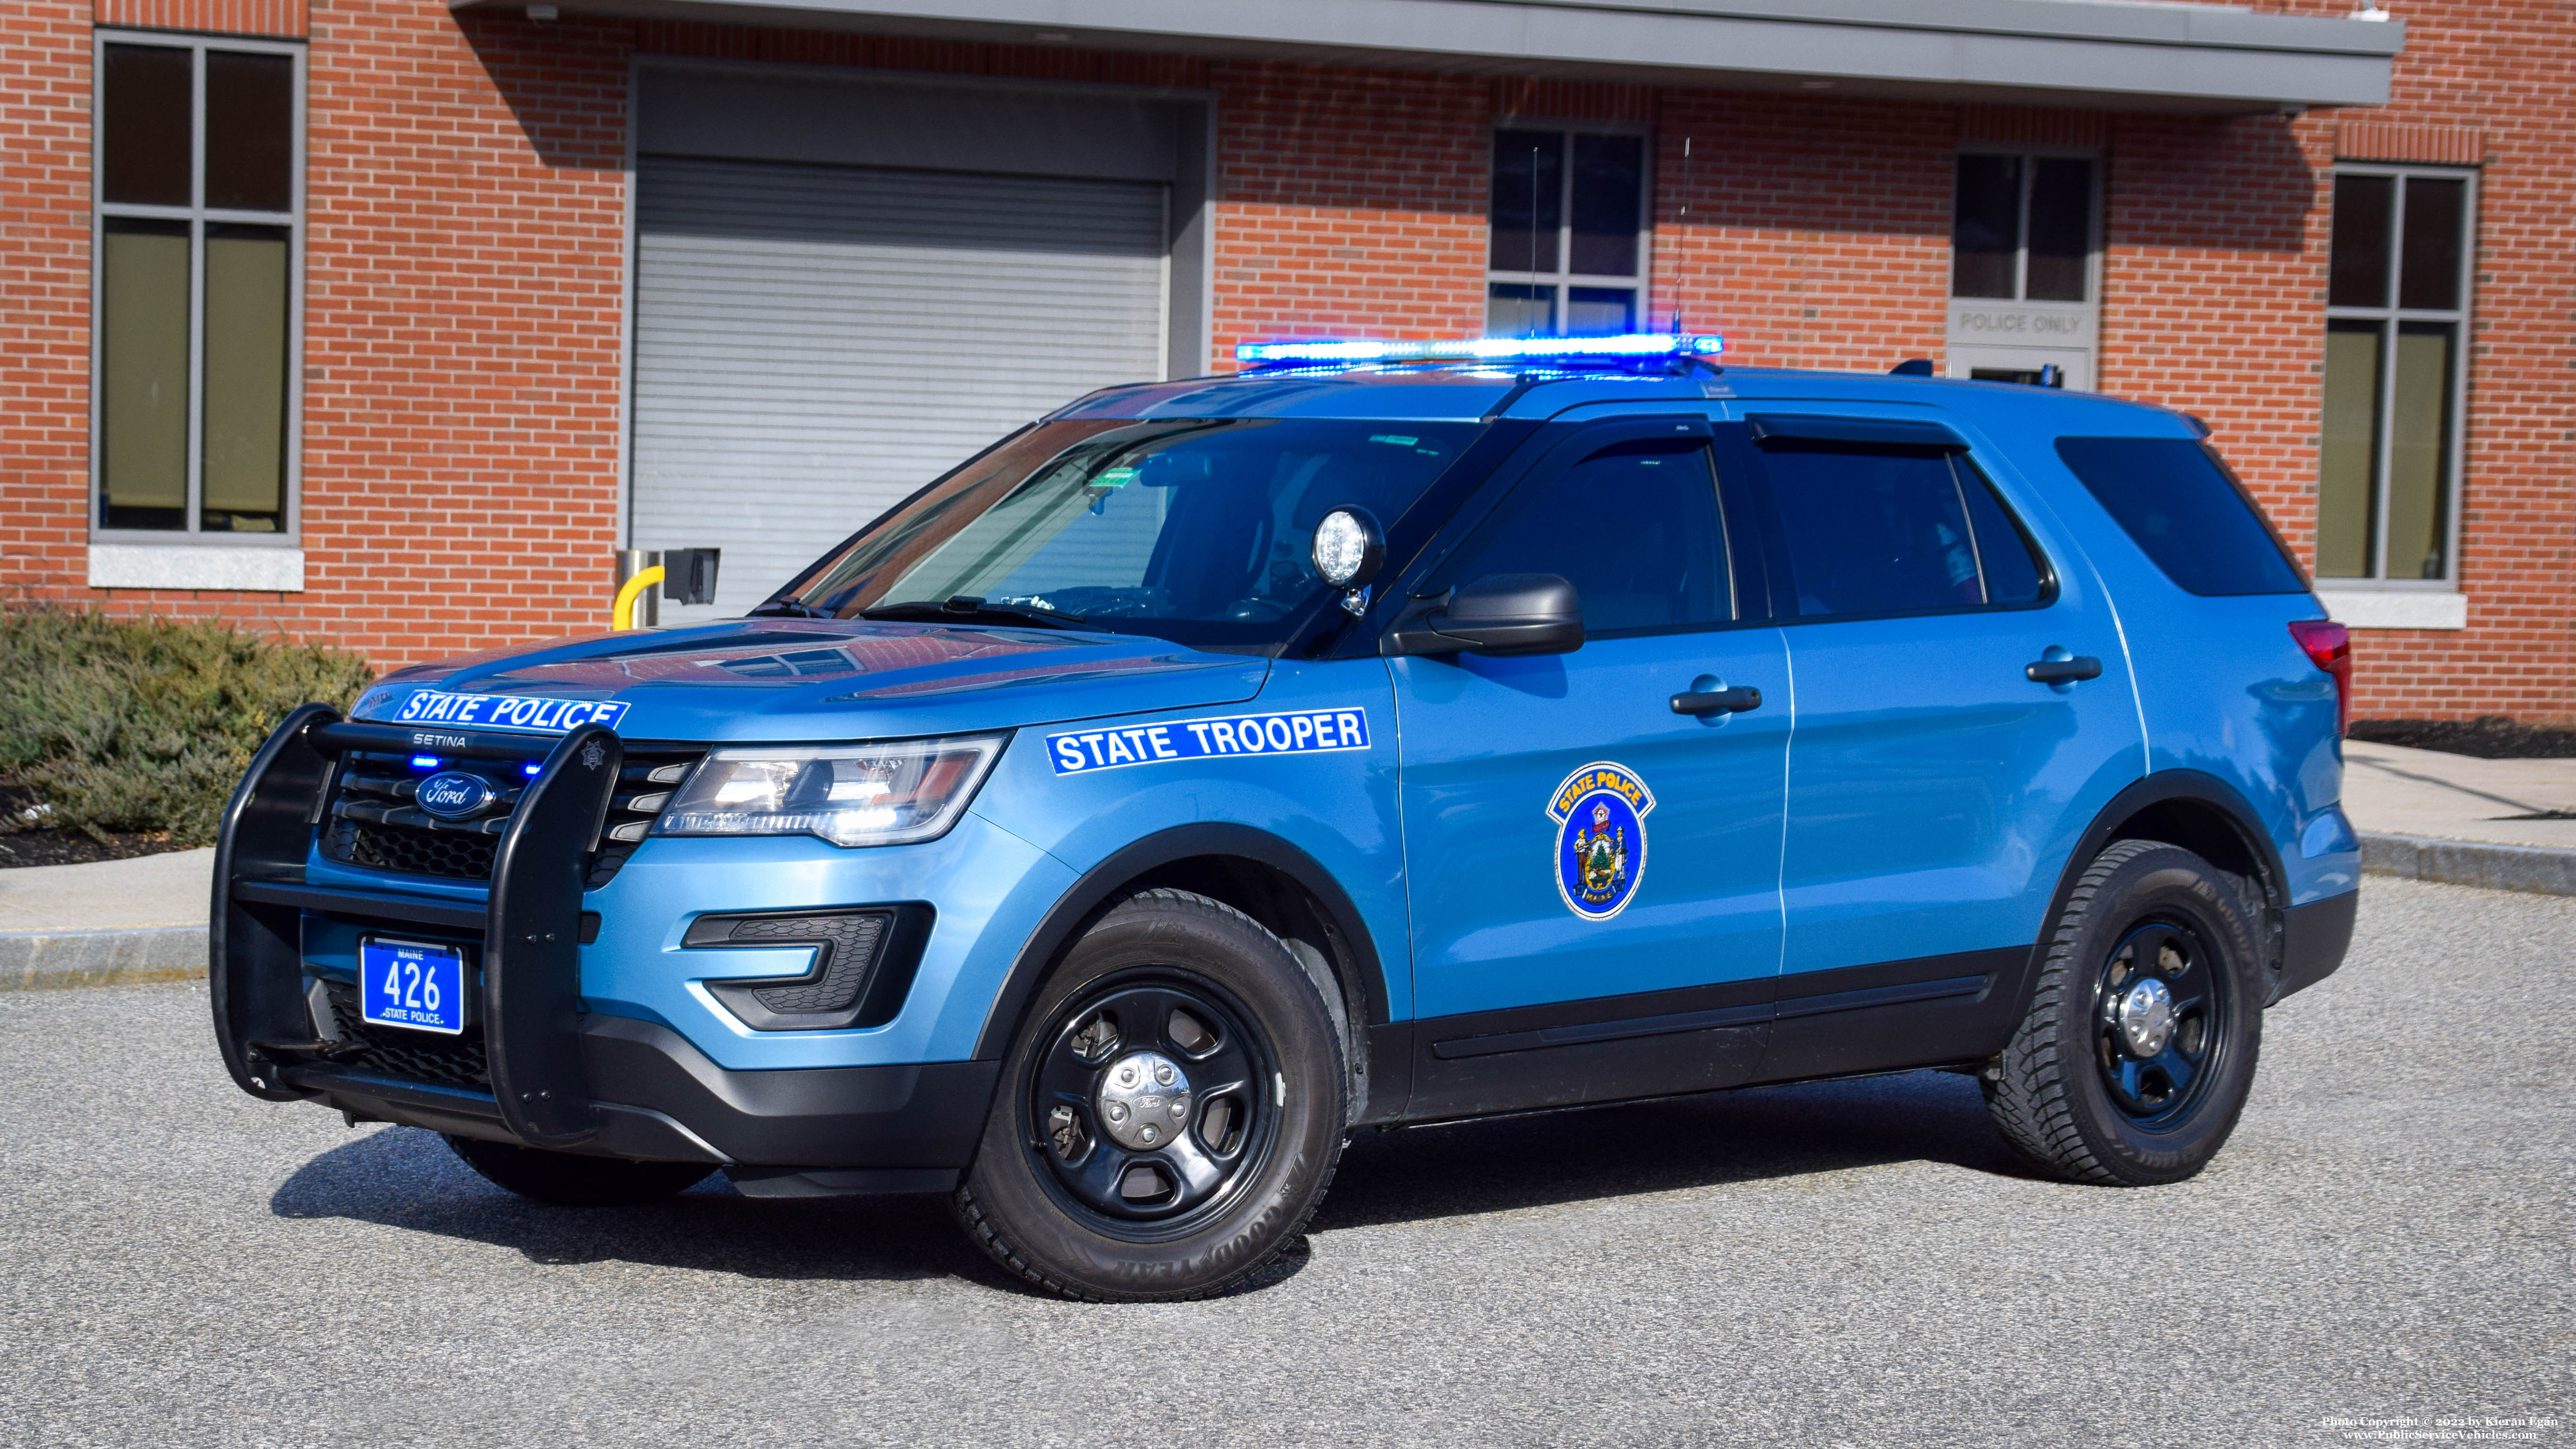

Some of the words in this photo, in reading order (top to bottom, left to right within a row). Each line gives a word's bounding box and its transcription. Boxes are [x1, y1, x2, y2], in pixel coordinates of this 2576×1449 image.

[1959, 313, 2027, 331] POLICE
[2034, 315, 2082, 332] ONLY
[402, 693, 490, 721] STATE
[489, 698, 618, 730] POLICE
[413, 733, 466, 748] SETINA
[1056, 728, 1178, 770] STATE
[1187, 712, 1363, 754] TROOPER
[426, 778, 470, 805] Ford
[1558, 774, 1595, 812] STATE
[1597, 771, 1642, 806] POLICE
[398, 948, 423, 960] MAINE
[383, 961, 440, 1011] 426
[385, 1007, 408, 1020] STATE
[411, 1011, 440, 1024] POLICE
[1139, 1097, 1160, 1108] Ford
[1111, 1205, 1281, 1278] GOODYEAR
